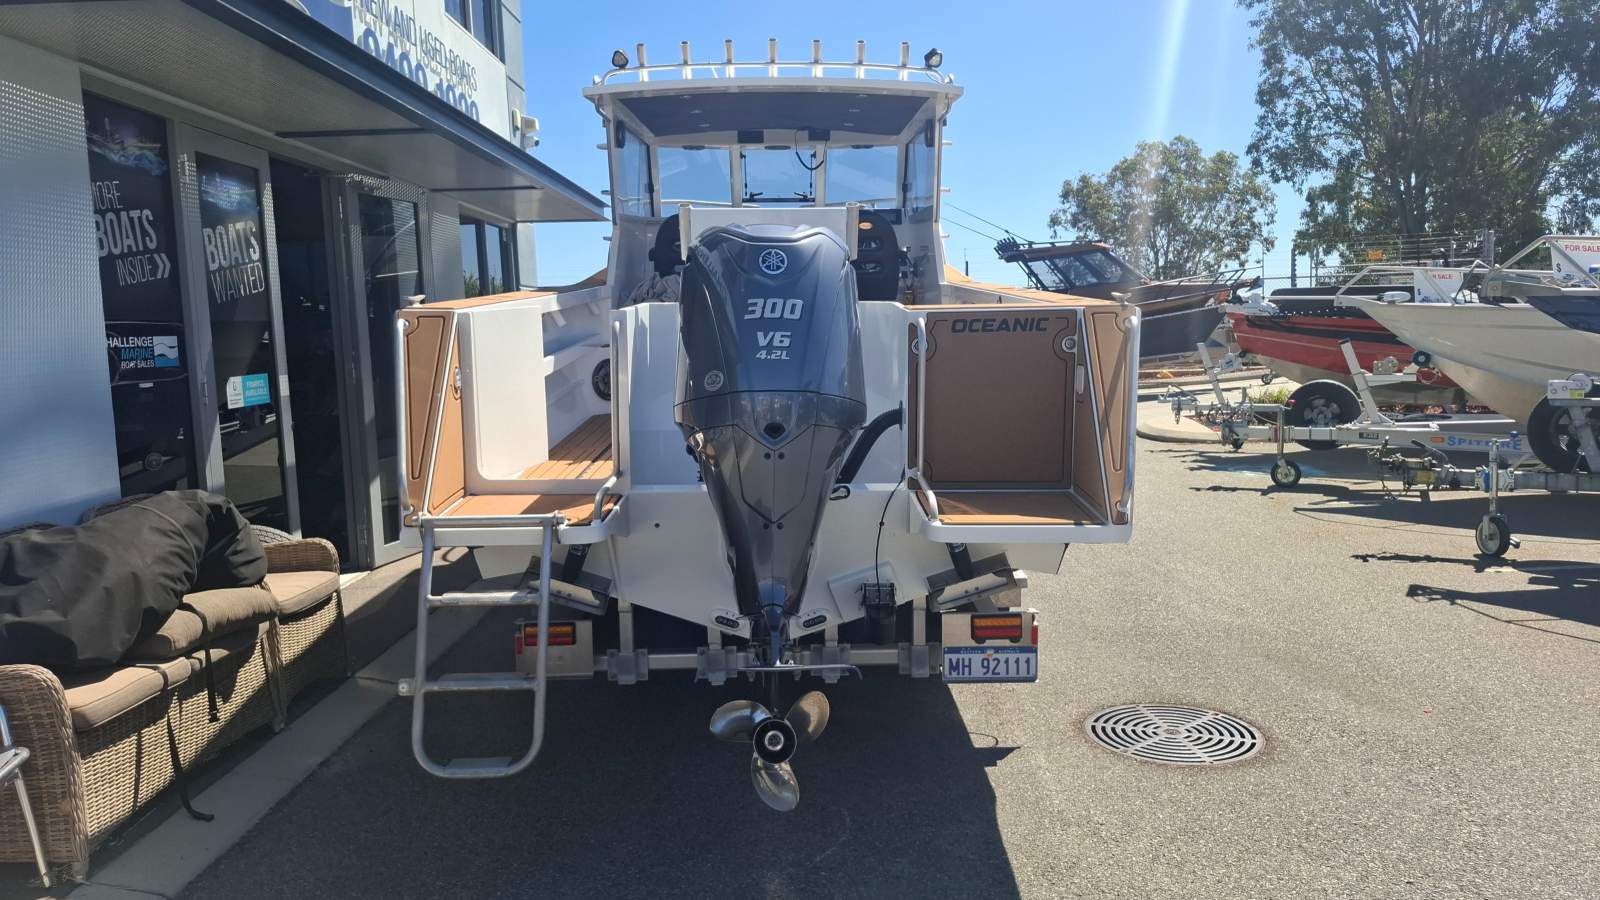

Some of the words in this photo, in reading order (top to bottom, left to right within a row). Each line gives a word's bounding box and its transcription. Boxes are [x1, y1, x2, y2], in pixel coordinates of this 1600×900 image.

[393, 5, 417, 47] AND
[419, 25, 447, 69] USED
[449, 48, 477, 92] BOATS
[95, 208, 158, 257] BOATS
[202, 220, 260, 272] BOATS
[1564, 244, 1580, 252] FOR
[115, 254, 156, 287] INSIDE
[210, 262, 265, 304] WANTED
[743, 298, 804, 320] 300
[951, 317, 1050, 333] OCEANIC
[105, 336, 153, 348] HALLENGE
[757, 331, 792, 347] V6
[121, 347, 153, 360] MARINE
[755, 350, 790, 360] 4.2L
[121, 360, 136, 369] BOAT
[137, 359, 154, 368] SALES
[949, 658, 972, 676] MH
[981, 657, 1030, 676] 92111
